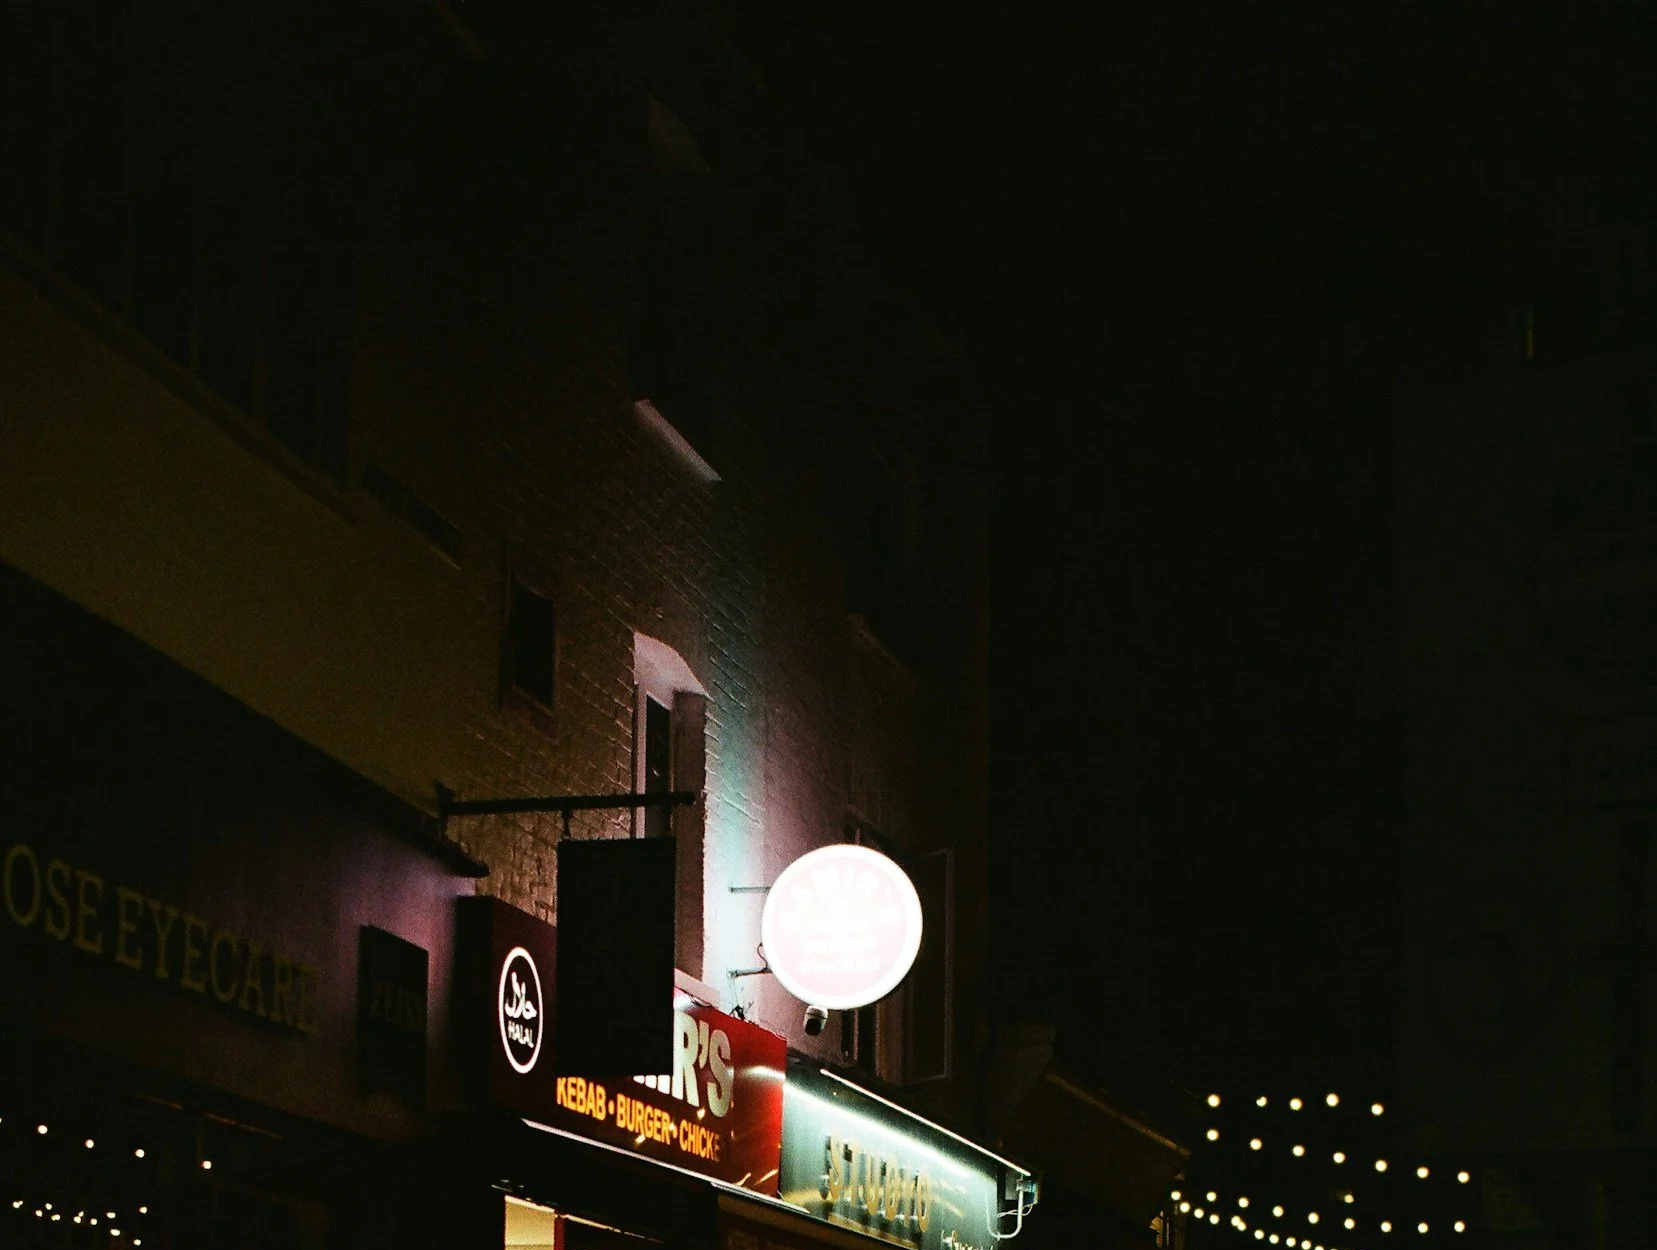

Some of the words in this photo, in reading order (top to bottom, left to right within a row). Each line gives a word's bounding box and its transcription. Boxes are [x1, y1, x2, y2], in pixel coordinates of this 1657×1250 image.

[114, 885, 320, 1038] EYECARE
[508, 1019, 535, 1048] HALAL
[556, 1076, 607, 1121] KEBAB
[616, 1092, 672, 1146] BURGER
[679, 1118, 721, 1163] CHICKE
